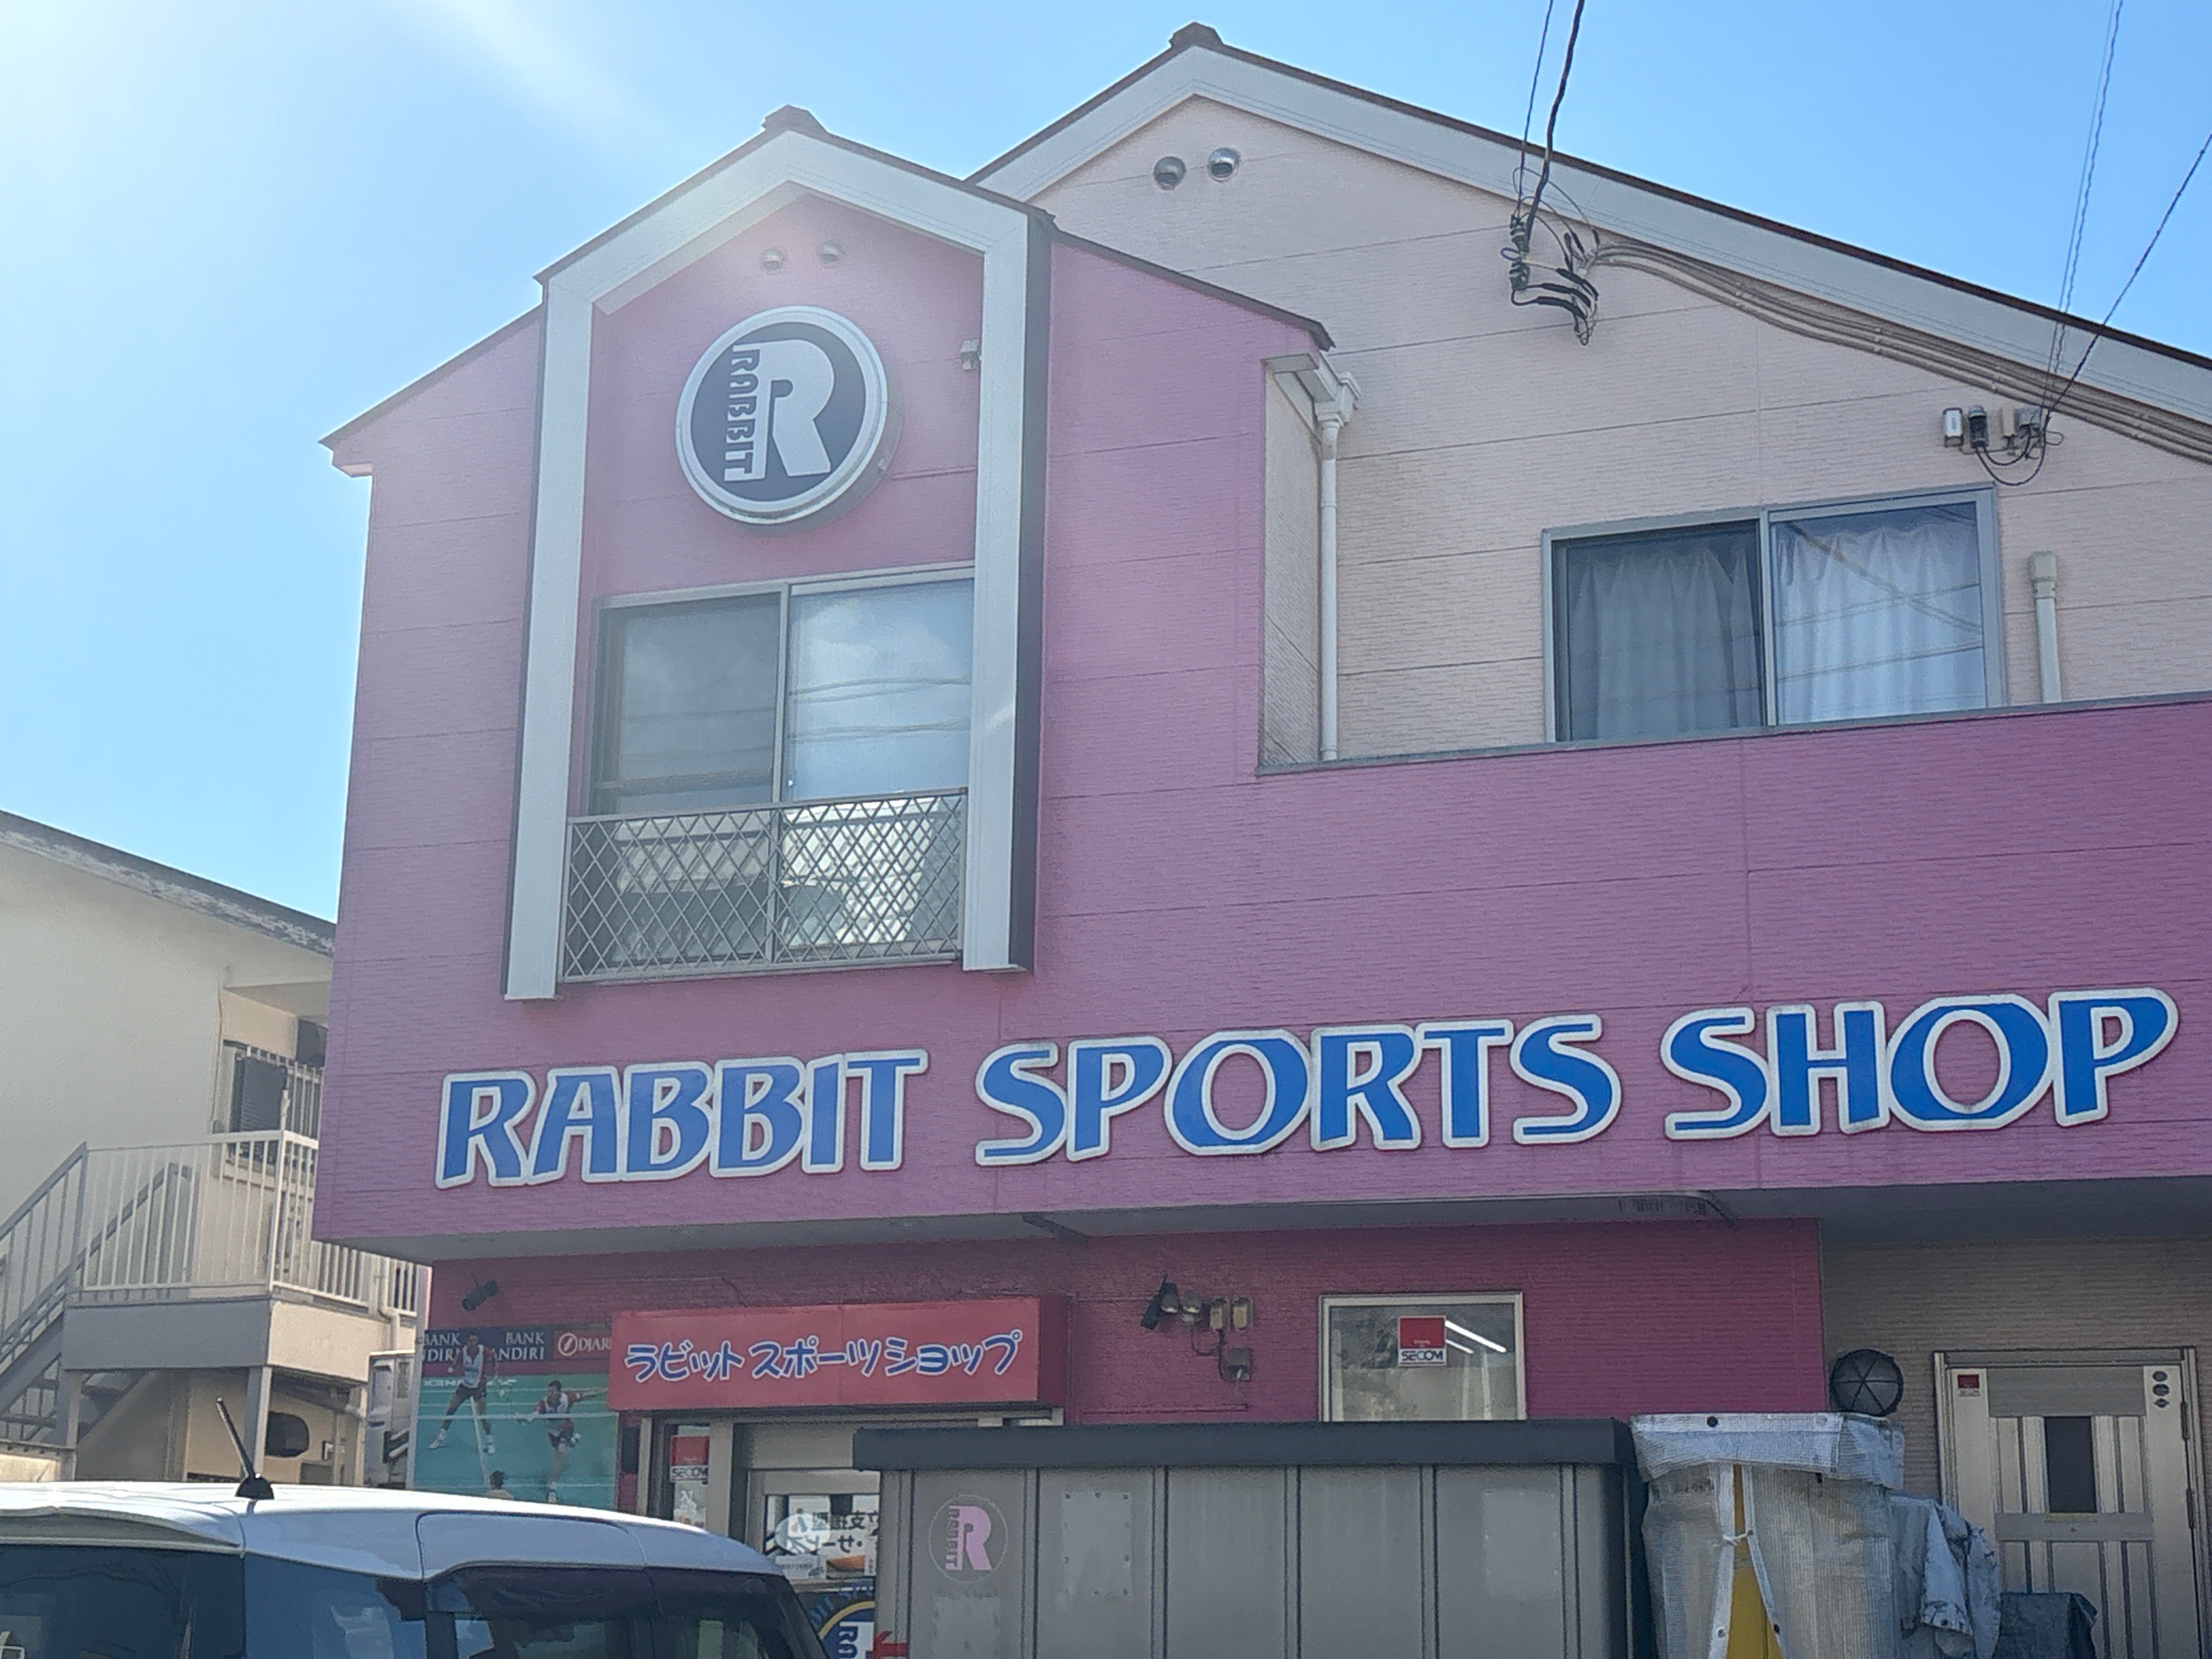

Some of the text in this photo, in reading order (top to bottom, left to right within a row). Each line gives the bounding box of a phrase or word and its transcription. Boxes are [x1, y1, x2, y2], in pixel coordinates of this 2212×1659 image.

[726, 347, 762, 477] RABBIT
[754, 339, 834, 482] R
[436, 988, 2179, 1188] RABBIT SPORTS SHOP
[505, 1331, 545, 1345] BANK
[624, 1329, 1023, 1383] ラビット スポーツ ショップ
[1402, 1350, 1443, 1361] SECOM
[672, 1467, 708, 1478] SECOM
[957, 1505, 992, 1571] R
